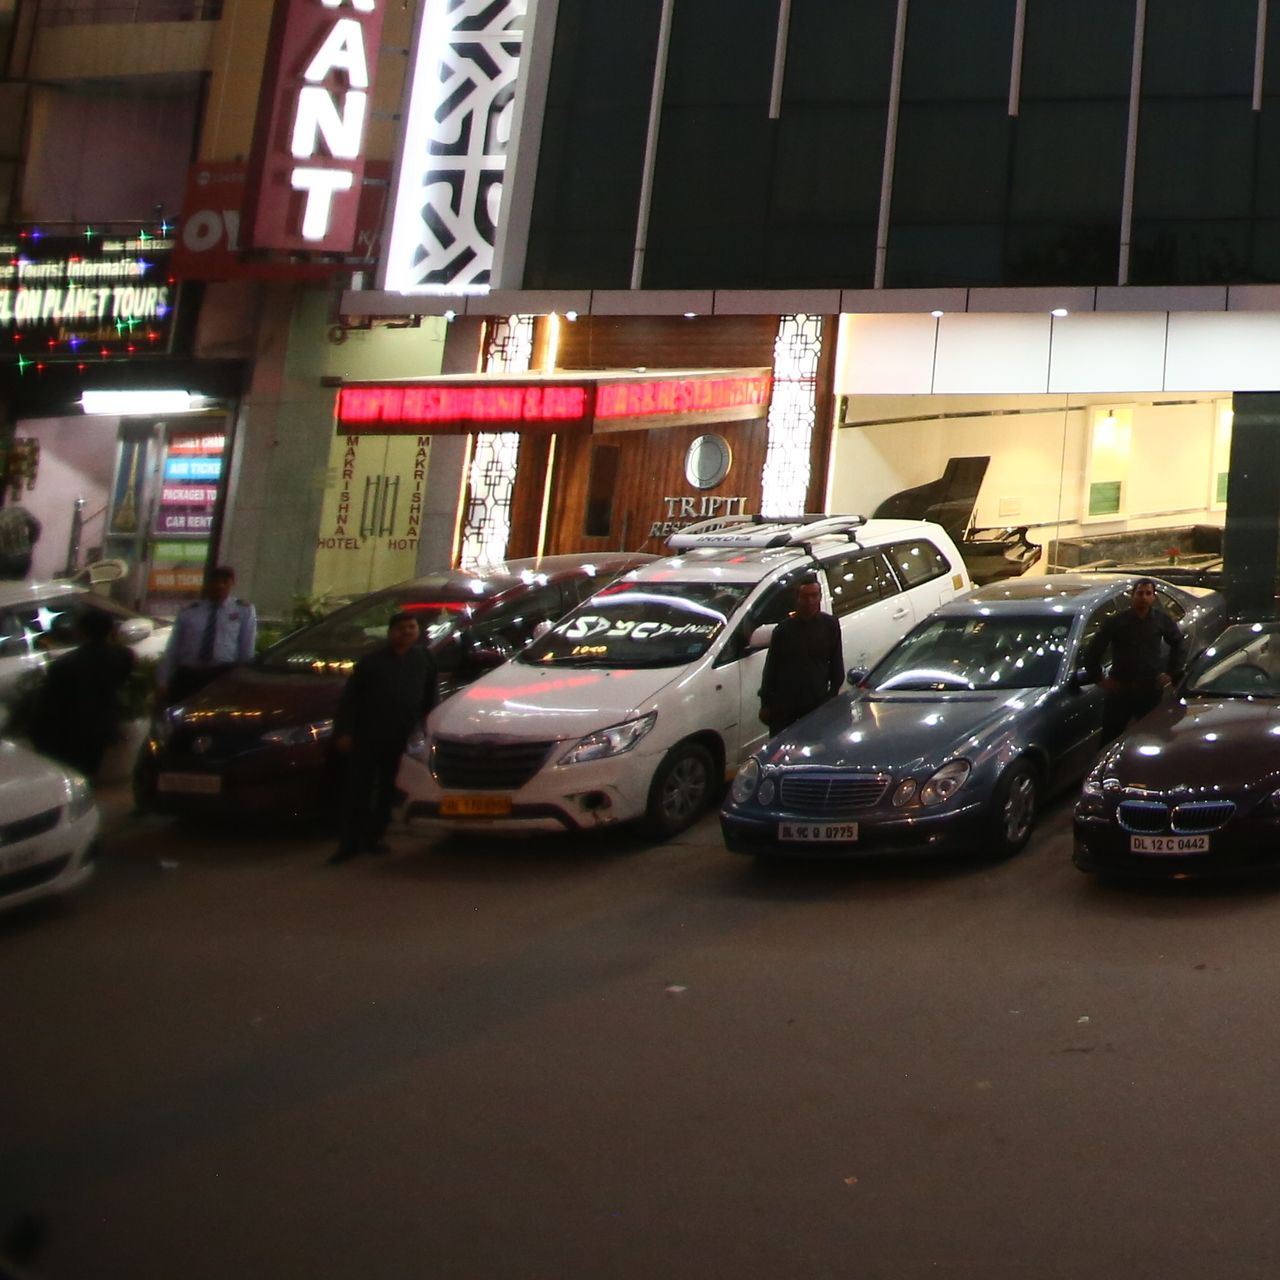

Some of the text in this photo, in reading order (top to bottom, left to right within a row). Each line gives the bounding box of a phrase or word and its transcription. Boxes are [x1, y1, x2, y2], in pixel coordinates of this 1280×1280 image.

[18, 260, 64, 277] Tourist
[43, 288, 110, 320] PLANET
[664, 497, 748, 518] TRIPTI
[166, 516, 185, 528] CAR
[317, 538, 360, 550] HOTEL
[825, 826, 853, 838] 0775
[1134, 838, 1205, 850] DL 12 C 0442
